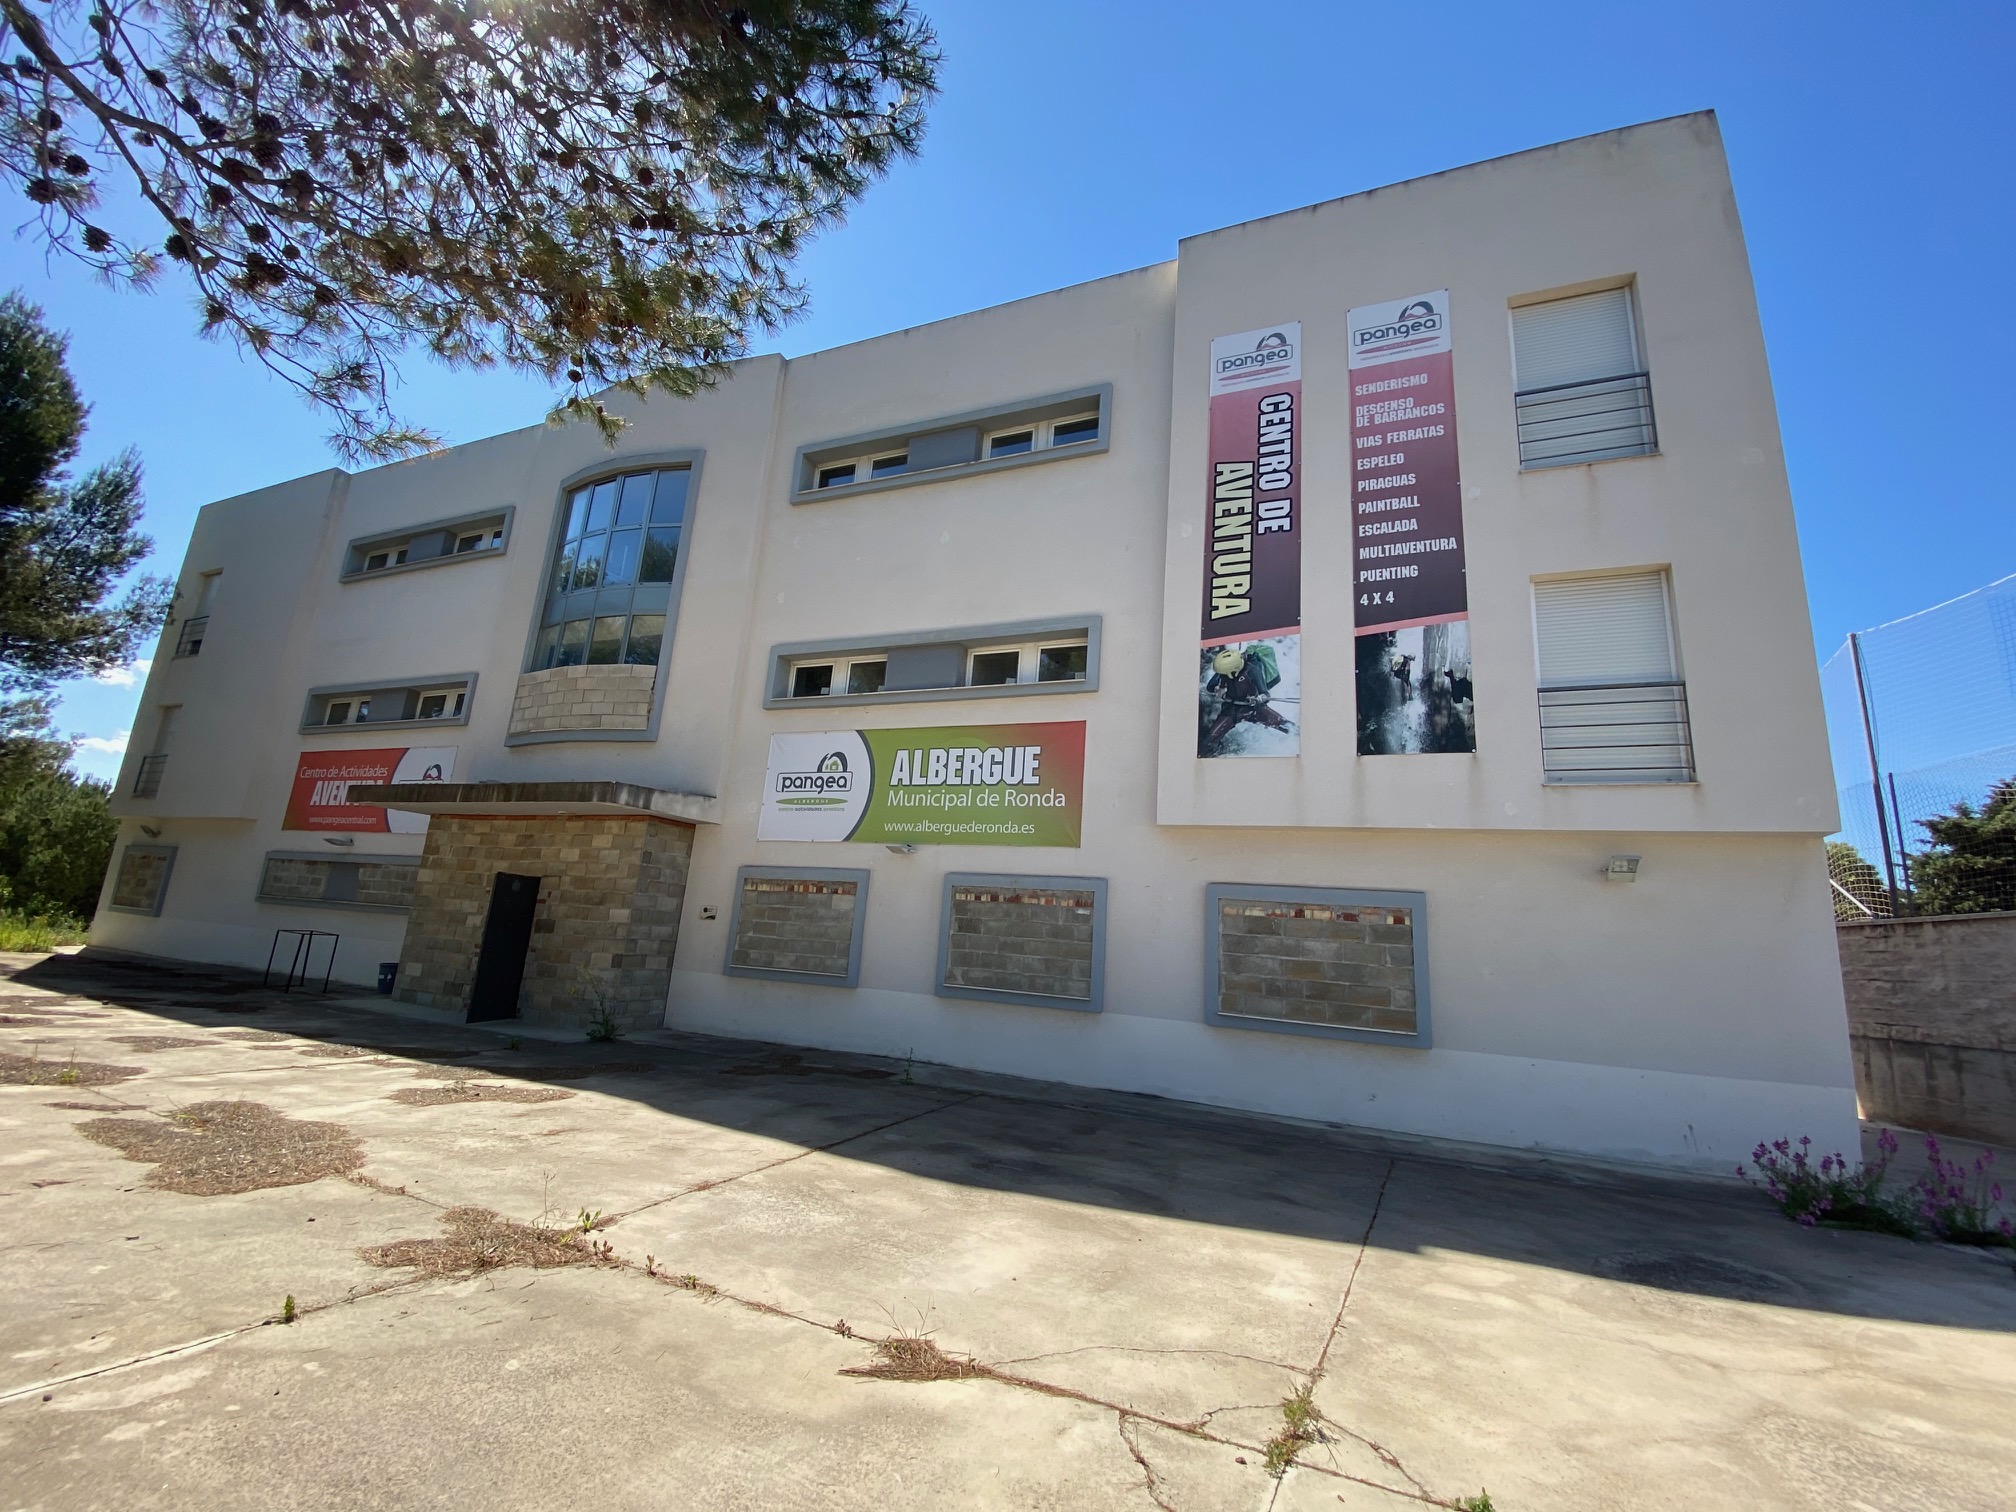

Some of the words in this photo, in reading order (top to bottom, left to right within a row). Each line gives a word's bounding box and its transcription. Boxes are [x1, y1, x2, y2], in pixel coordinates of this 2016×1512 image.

[1359, 318, 1436, 345] pangea
[1222, 348, 1289, 372] pangea
[1355, 373, 1428, 396] SENDERISMO
[1356, 397, 1414, 417] DESCENSO
[1356, 416, 1371, 428] DE
[1374, 402, 1445, 425] BARRANCOS
[1257, 392, 1294, 493] CENTRO
[1356, 434, 1383, 449] VIAS
[1386, 424, 1445, 444] FERRATAS
[1357, 453, 1405, 471] ESPELEO
[1358, 473, 1416, 492] PIRAGUAS
[1358, 495, 1421, 514] PAINTBALL
[1257, 498, 1292, 535] DE
[1358, 518, 1418, 537] ESCALADA
[1211, 461, 1254, 620] AVENTURA
[1359, 537, 1458, 560] MULTIAVENTURA
[1359, 565, 1419, 583] PUENTING
[1360, 593, 1369, 605] 4
[1385, 591, 1395, 604] 4
[300, 766, 327, 779] Centro
[327, 766, 339, 778] de
[339, 764, 389, 778] Actividades
[889, 745, 1041, 786] ALBERGUE
[310, 780, 384, 806] AVEN
[781, 775, 848, 795] pangea
[887, 788, 972, 810] Municipal
[975, 788, 1001, 807] de
[1005, 787, 1066, 807] Ronda
[309, 815, 377, 826] www.pangeacentral.com
[884, 819, 1035, 834] www.alberguederonda.es
